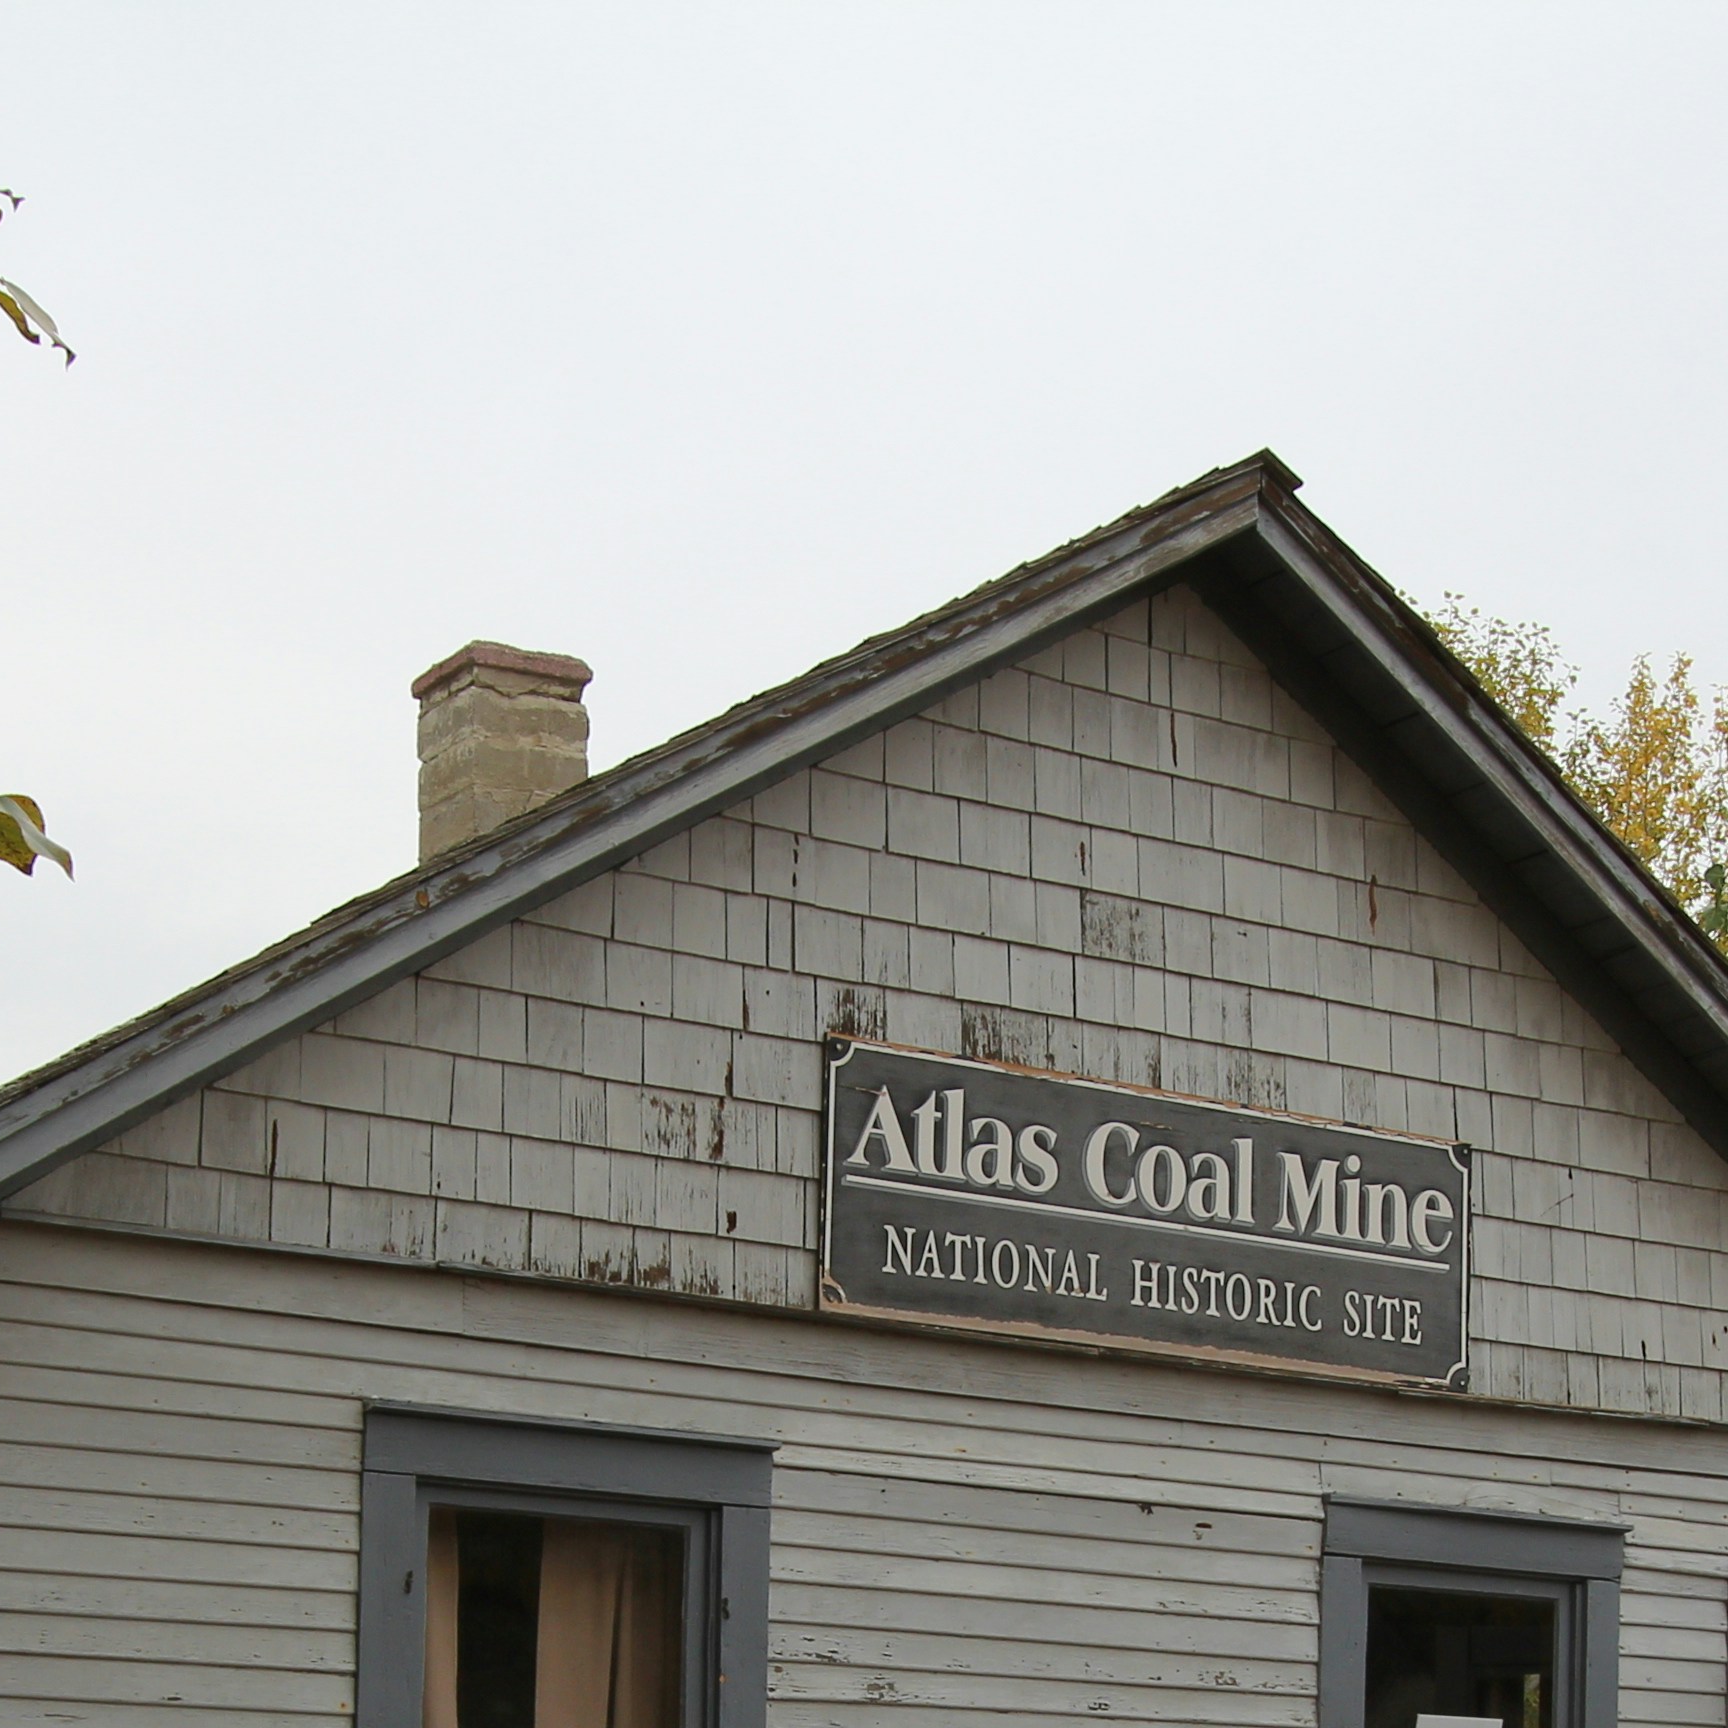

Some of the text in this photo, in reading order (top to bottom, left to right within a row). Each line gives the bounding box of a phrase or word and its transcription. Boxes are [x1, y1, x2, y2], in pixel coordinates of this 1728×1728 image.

[843, 1085, 1454, 1255] Atlas Coal Mine
[882, 1224, 1424, 1346] NATIONAL HISTORIC SITE
